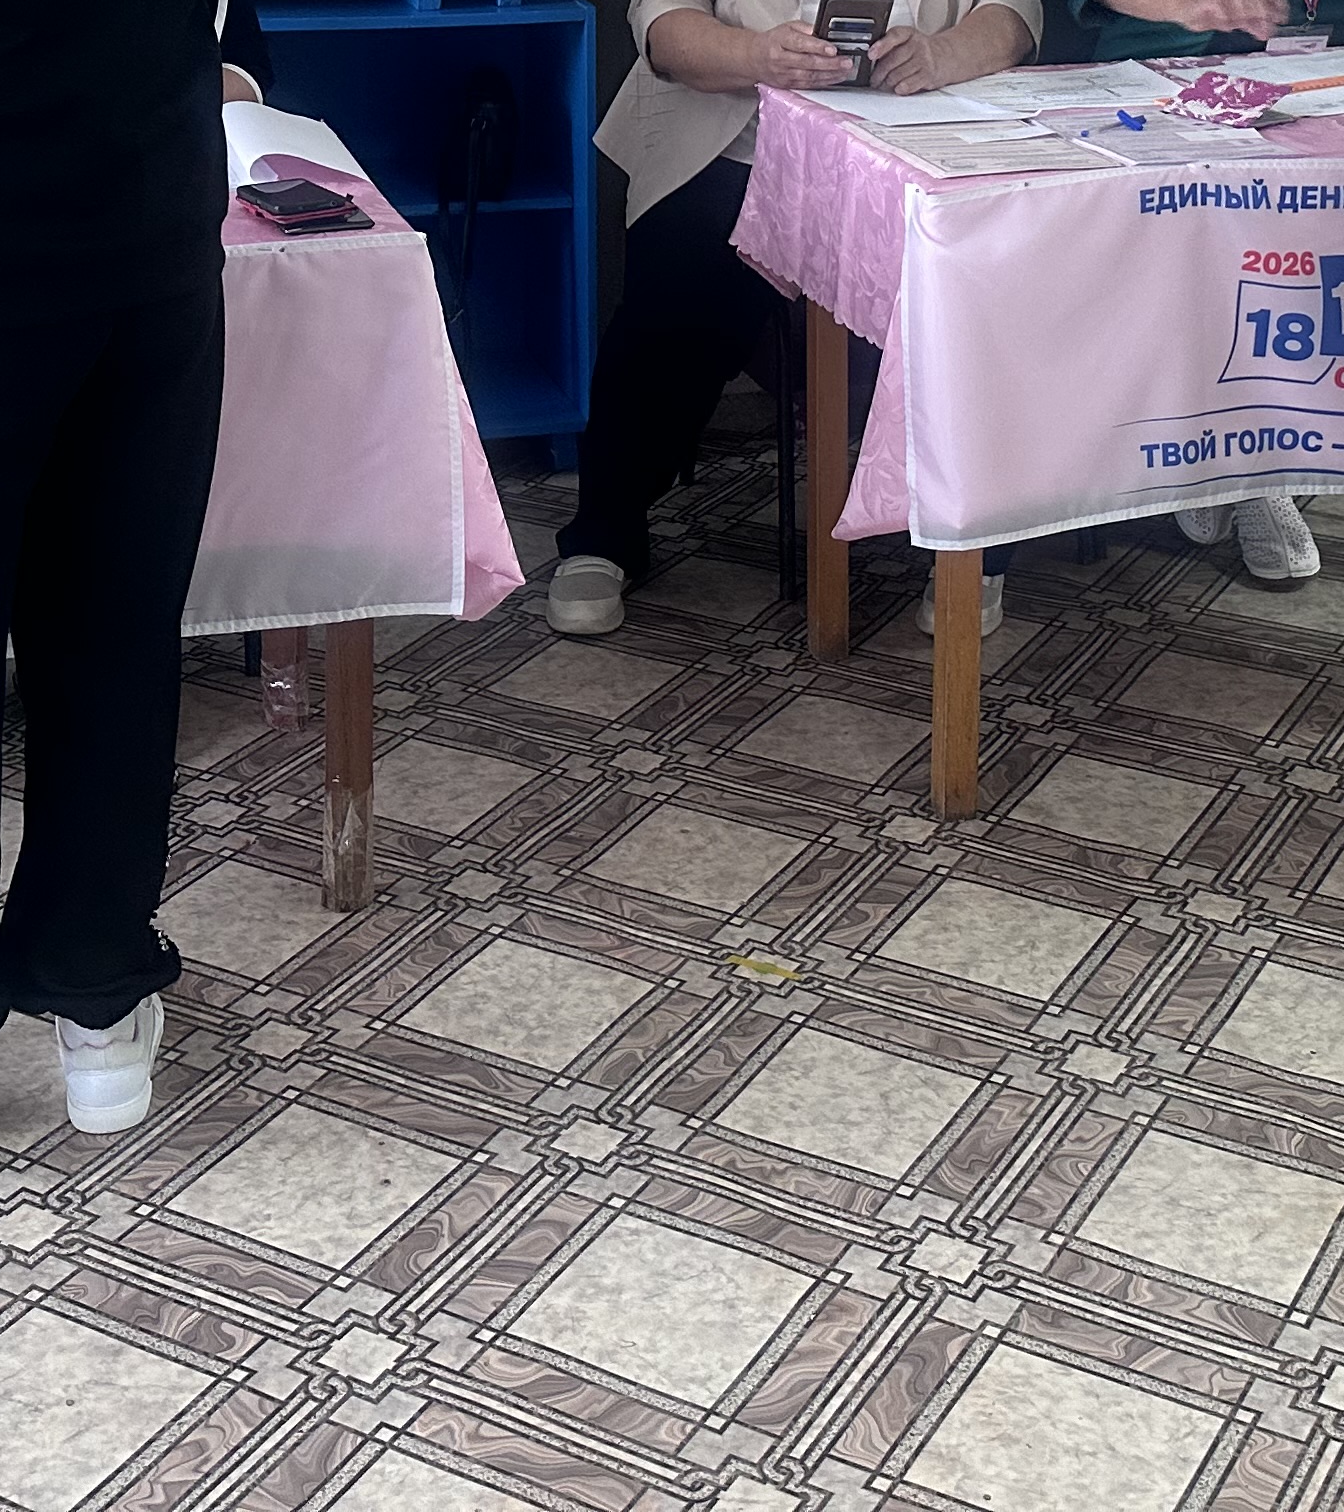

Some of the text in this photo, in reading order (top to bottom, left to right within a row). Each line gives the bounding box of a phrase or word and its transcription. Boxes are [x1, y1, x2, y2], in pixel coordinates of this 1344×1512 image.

[1139, 179, 1271, 215] ЕДИНЫЙ
[1241, 250, 1315, 276] 2026
[1246, 308, 1316, 362] 18
[1140, 430, 1217, 469] ТВОЙ
[1224, 427, 1324, 457] ГОЛОС
